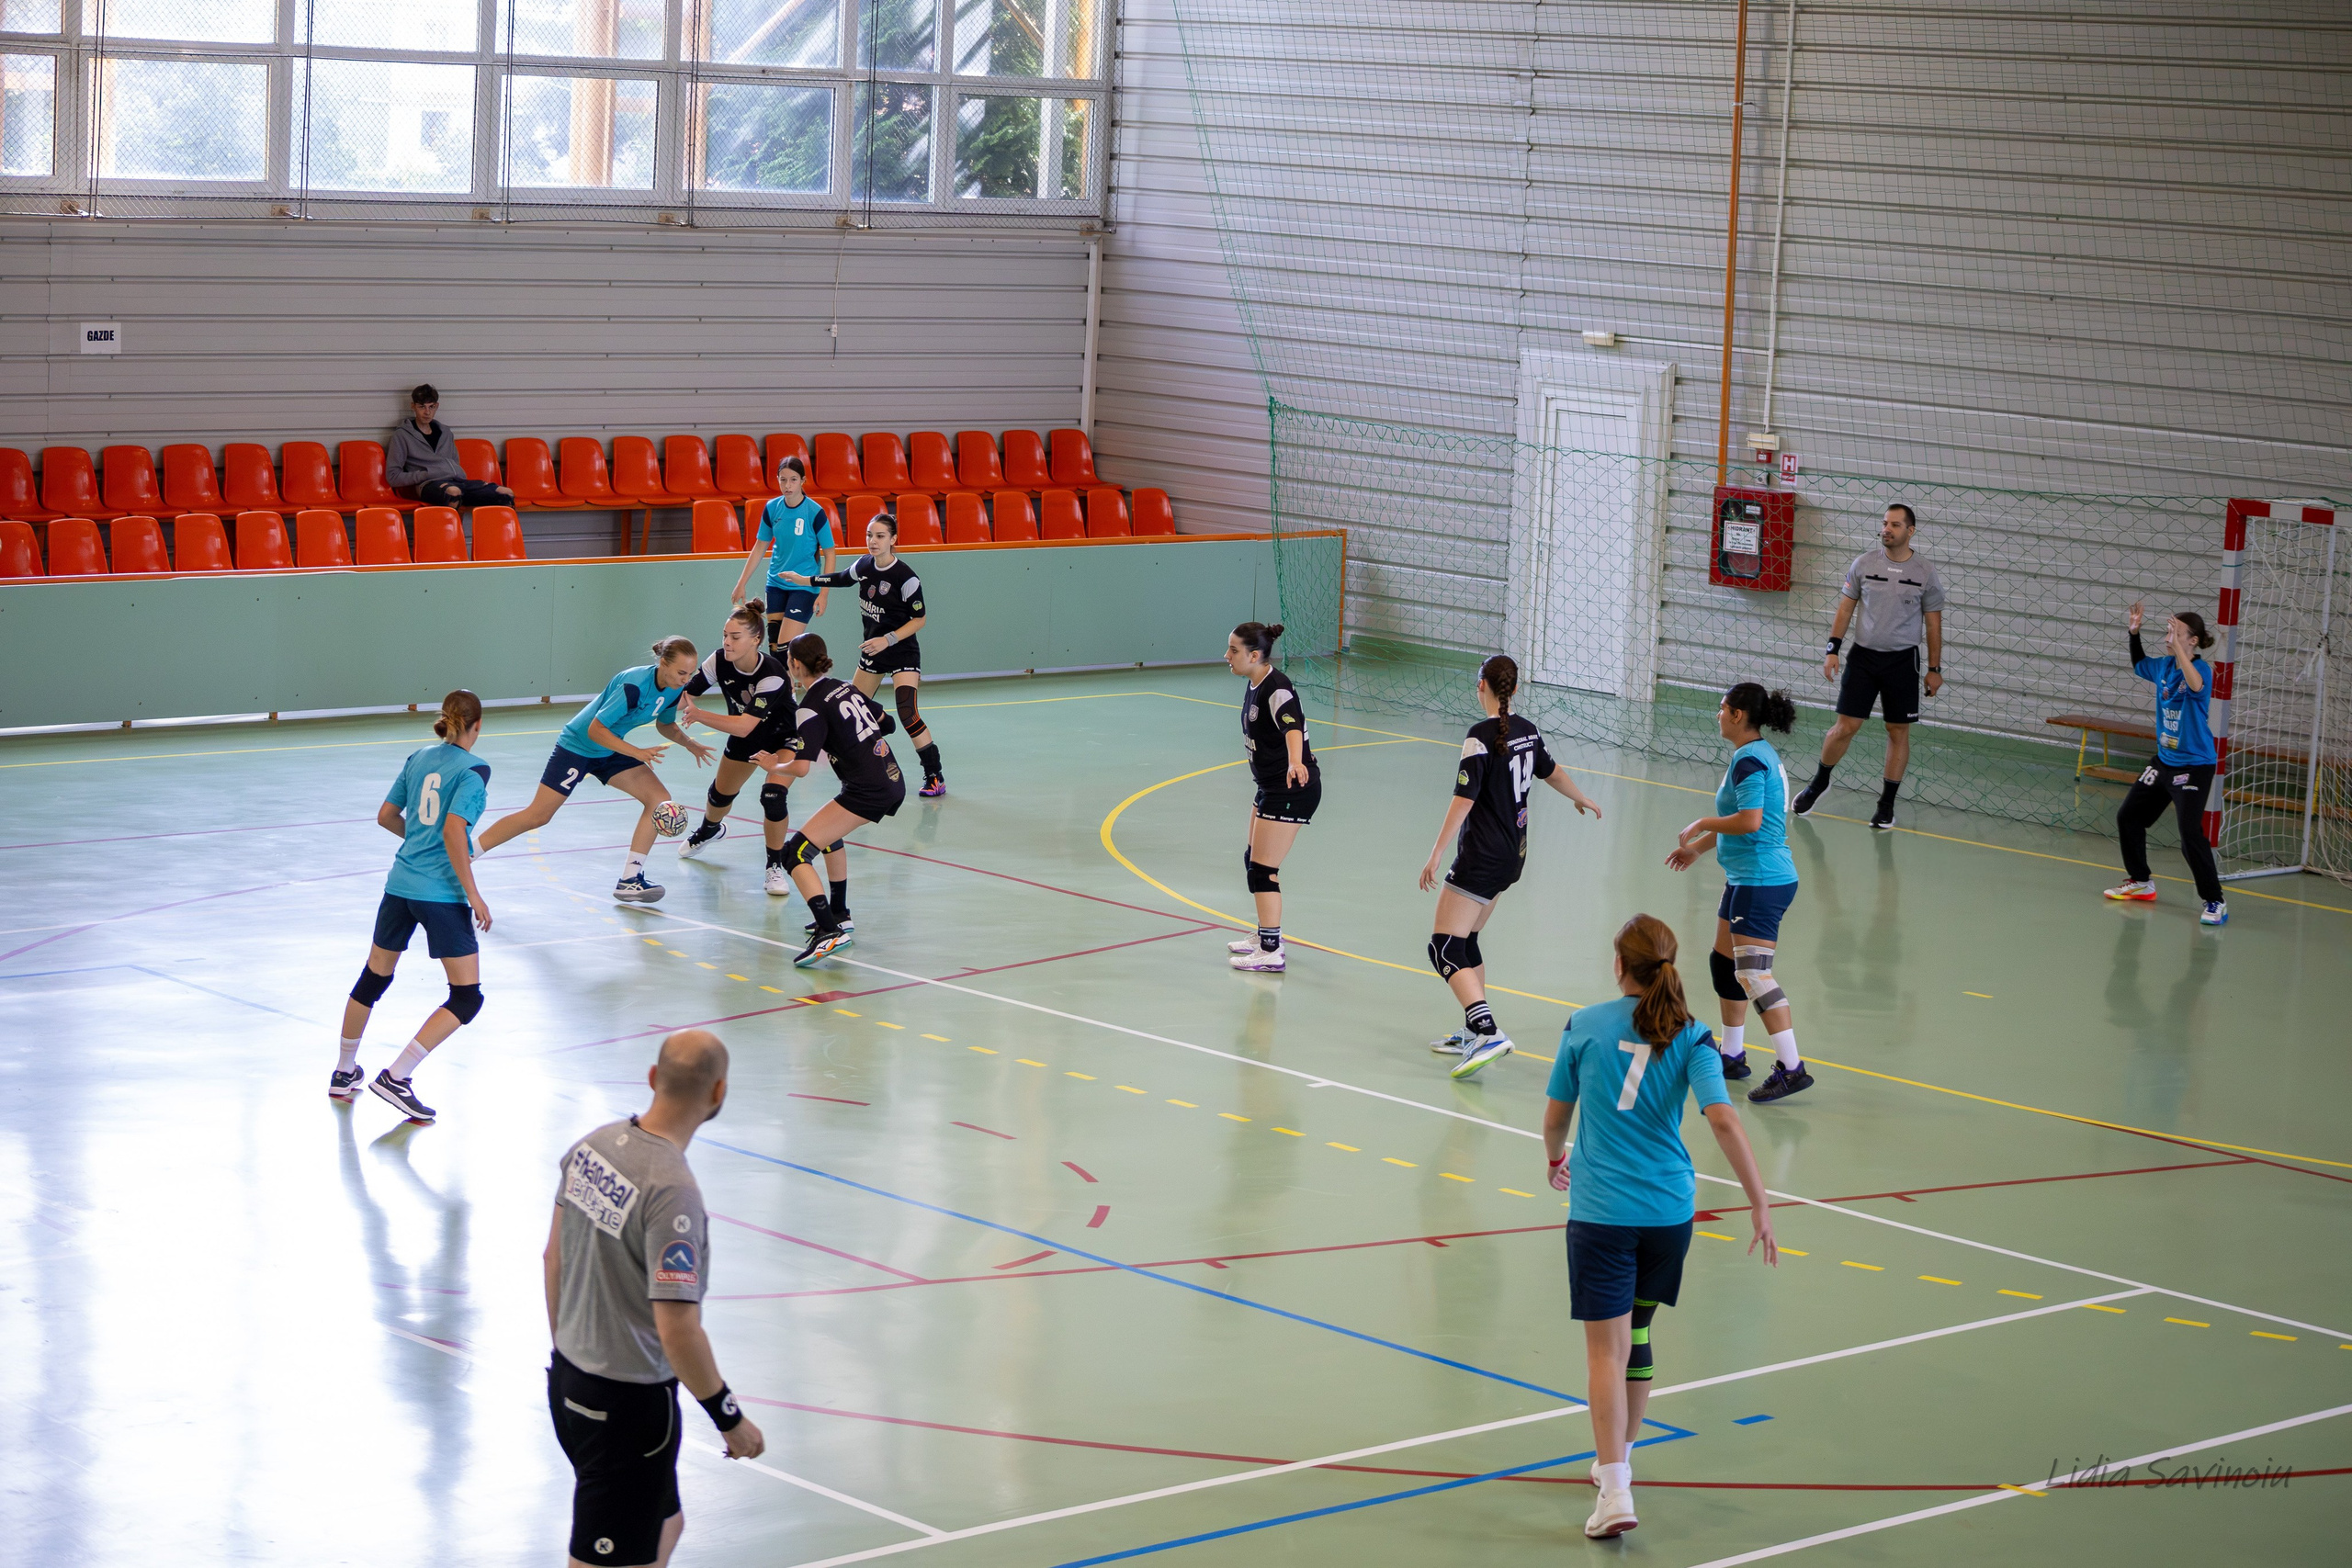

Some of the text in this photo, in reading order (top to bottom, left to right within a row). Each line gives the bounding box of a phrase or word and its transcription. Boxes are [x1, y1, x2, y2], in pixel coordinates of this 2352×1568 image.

[87, 330, 115, 342] GAZDE
[1783, 457, 1795, 471] H
[795, 517, 805, 536] 9
[651, 696, 664, 716] 2
[839, 694, 879, 742] 26
[560, 767, 579, 790] 2
[1509, 750, 1533, 803] 14
[2138, 765, 2159, 786] 16
[418, 773, 441, 826] 6
[1617, 1040, 1651, 1111] 7
[574, 1150, 634, 1210] #handbal
